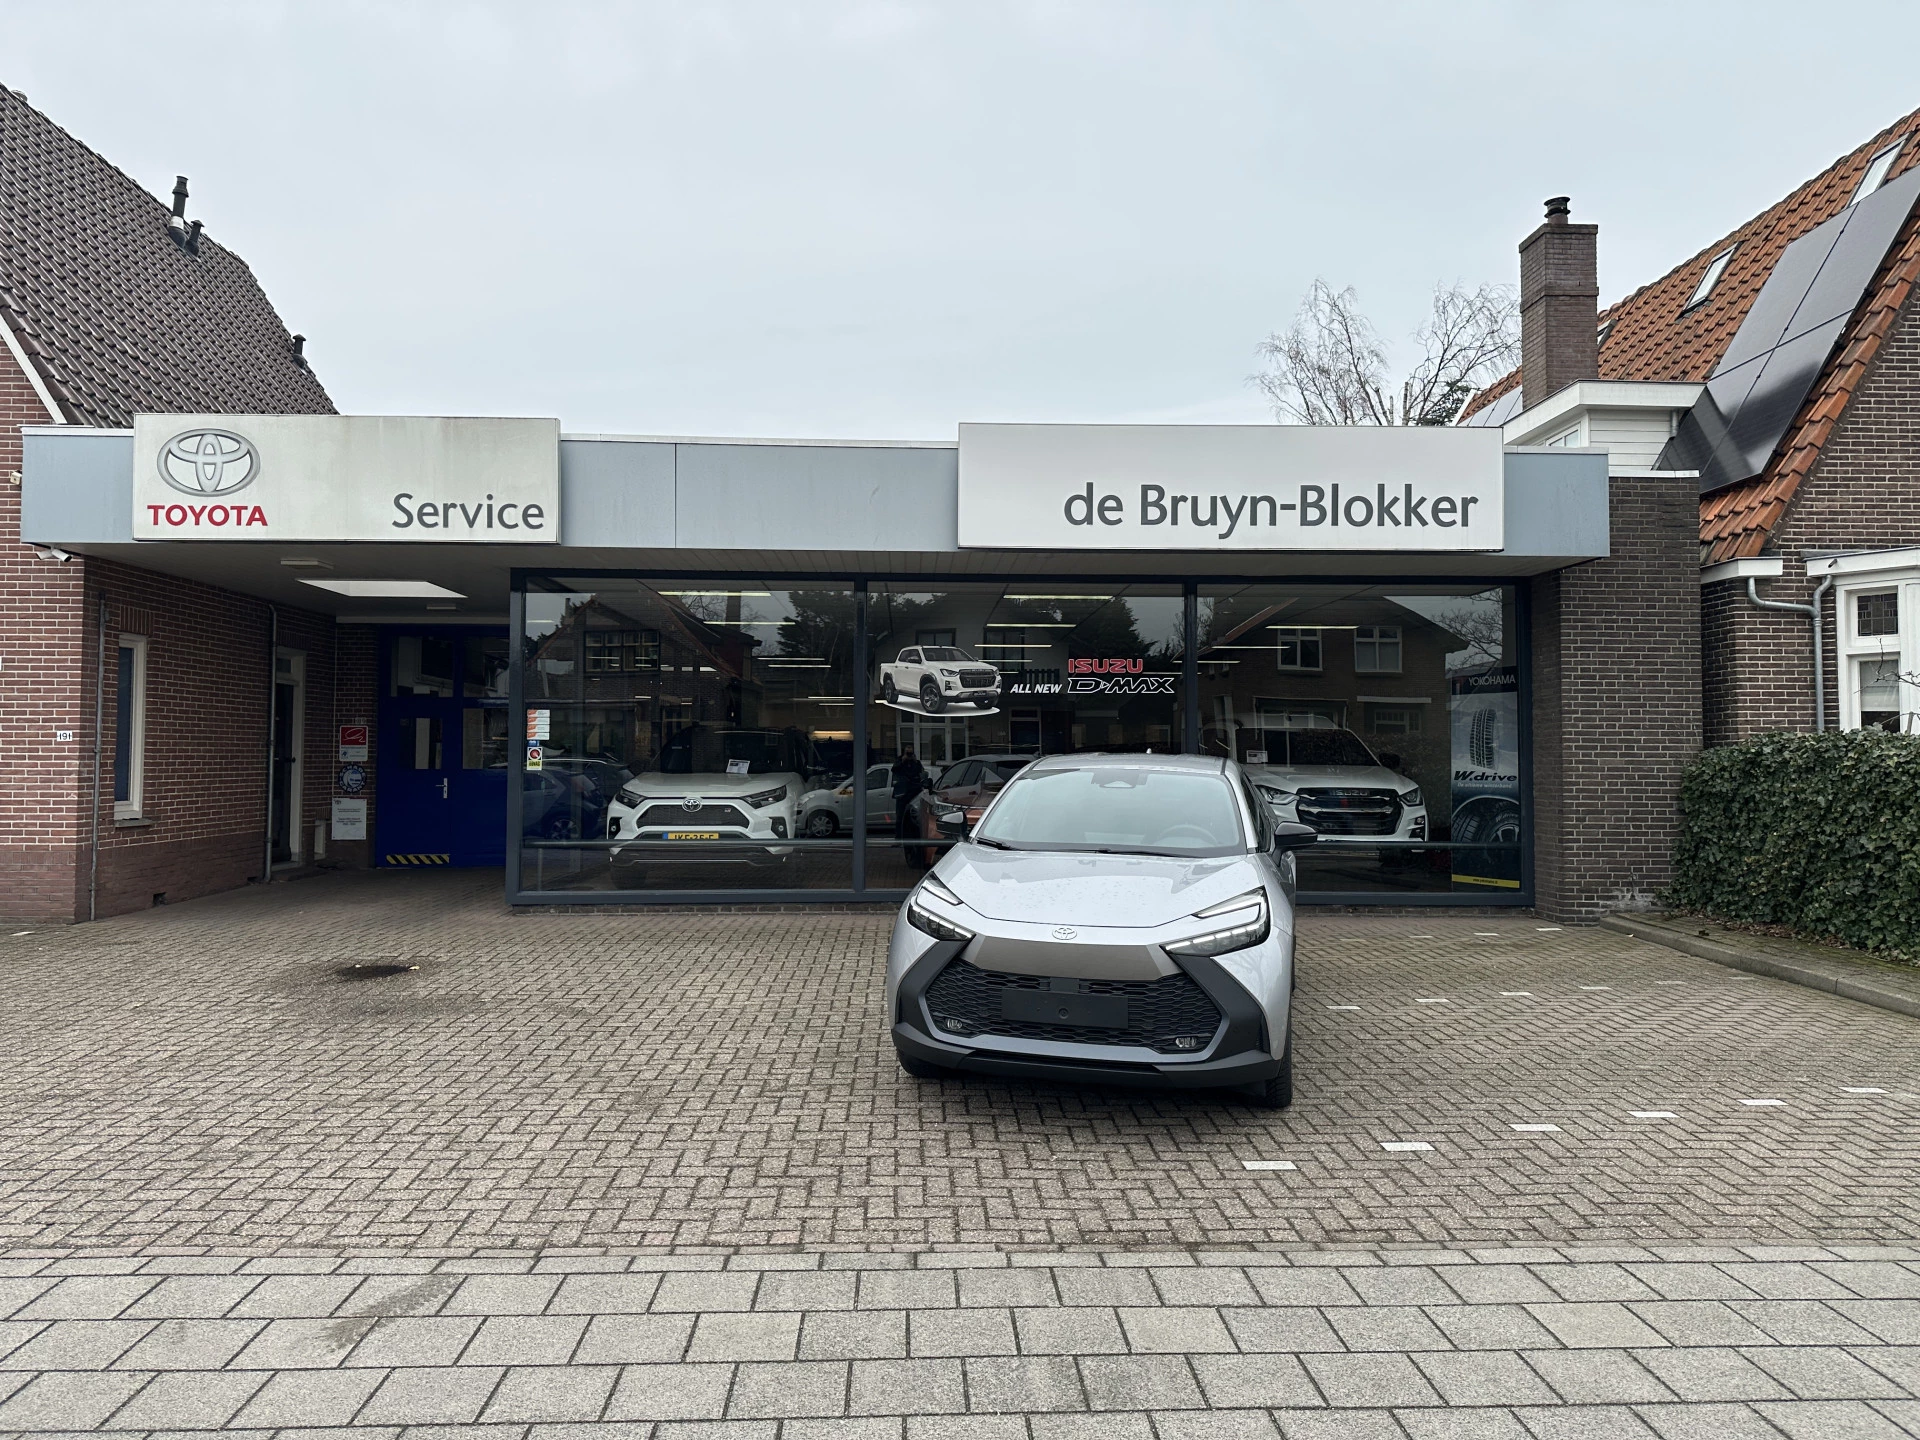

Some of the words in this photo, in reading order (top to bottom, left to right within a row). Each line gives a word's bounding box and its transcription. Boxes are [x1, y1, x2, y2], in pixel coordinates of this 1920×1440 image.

[146, 504, 269, 527] TOYOTA
[392, 492, 544, 529] Service
[1063, 481, 1124, 526] de
[1139, 483, 1479, 540] Bruyn-Blokker
[1067, 658, 1144, 674] ISUZU
[1010, 683, 1032, 694] ALL
[1034, 683, 1063, 694] NEW
[1468, 674, 1516, 687] YOKOHAMA
[1453, 770, 1518, 782] W.drive
